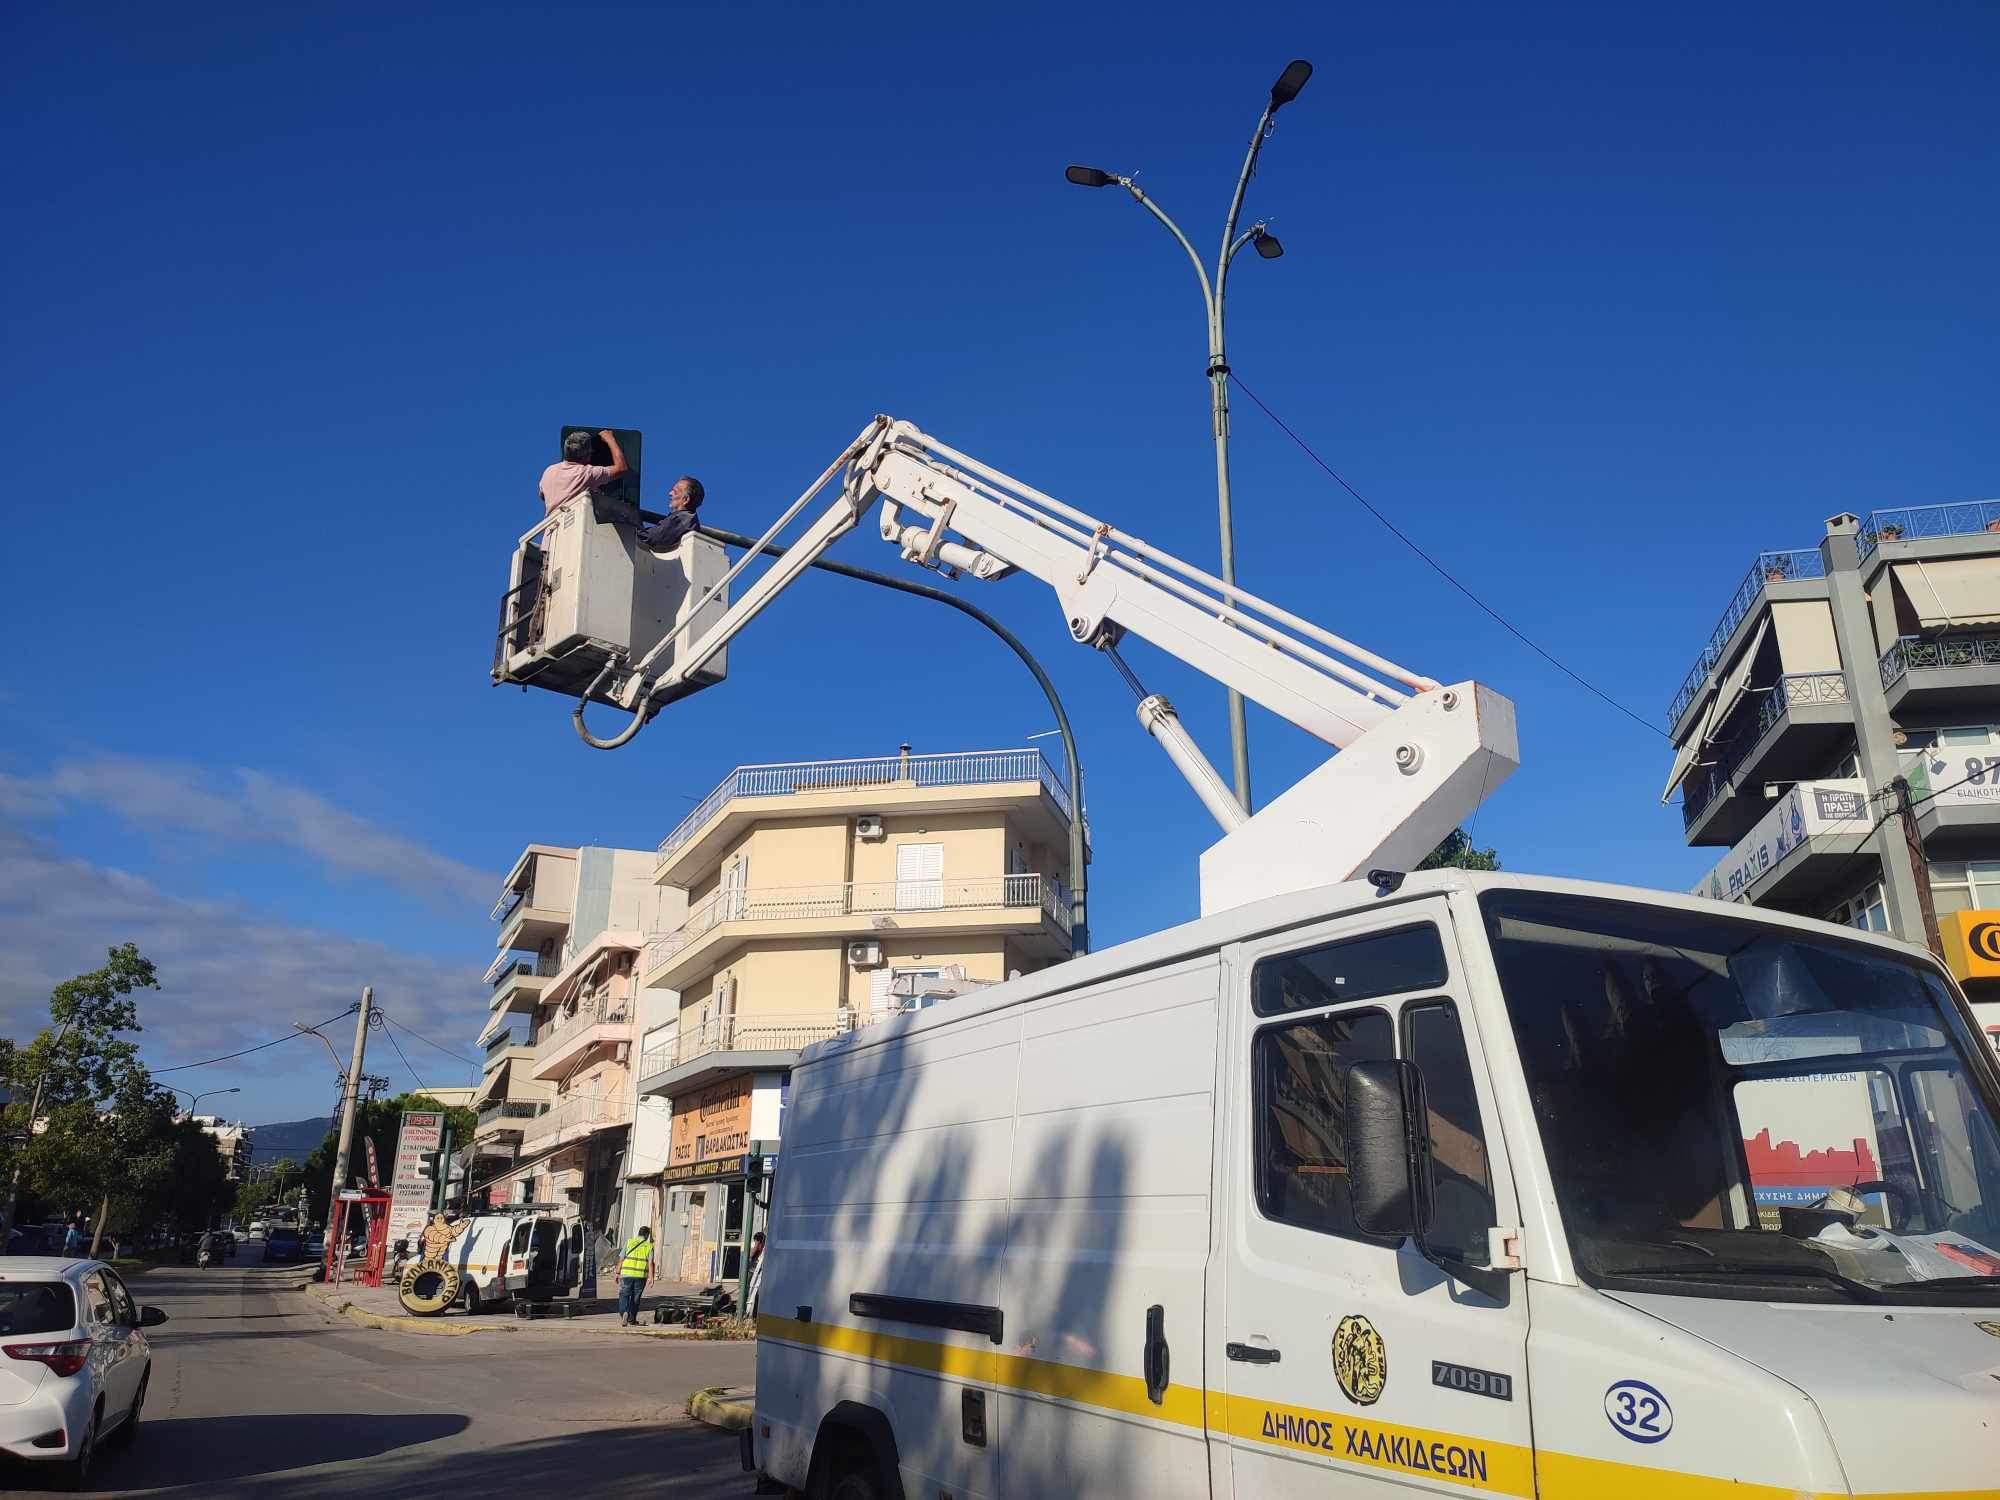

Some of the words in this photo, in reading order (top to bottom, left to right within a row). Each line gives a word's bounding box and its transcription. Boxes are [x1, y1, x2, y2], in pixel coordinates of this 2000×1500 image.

[1823, 801, 1856, 813] ΠΡΑΞΗ
[1829, 793, 1855, 802] ΠΡΩΤΗ
[1728, 844, 1769, 896] PRAXIS
[1432, 1364, 1508, 1396] 709D
[1616, 1391, 1660, 1433] 32
[1262, 1410, 1334, 1450] ΔΗΜΟΣ
[1344, 1425, 1488, 1482] ΧΑΛΚΙΔΕΩΝ
